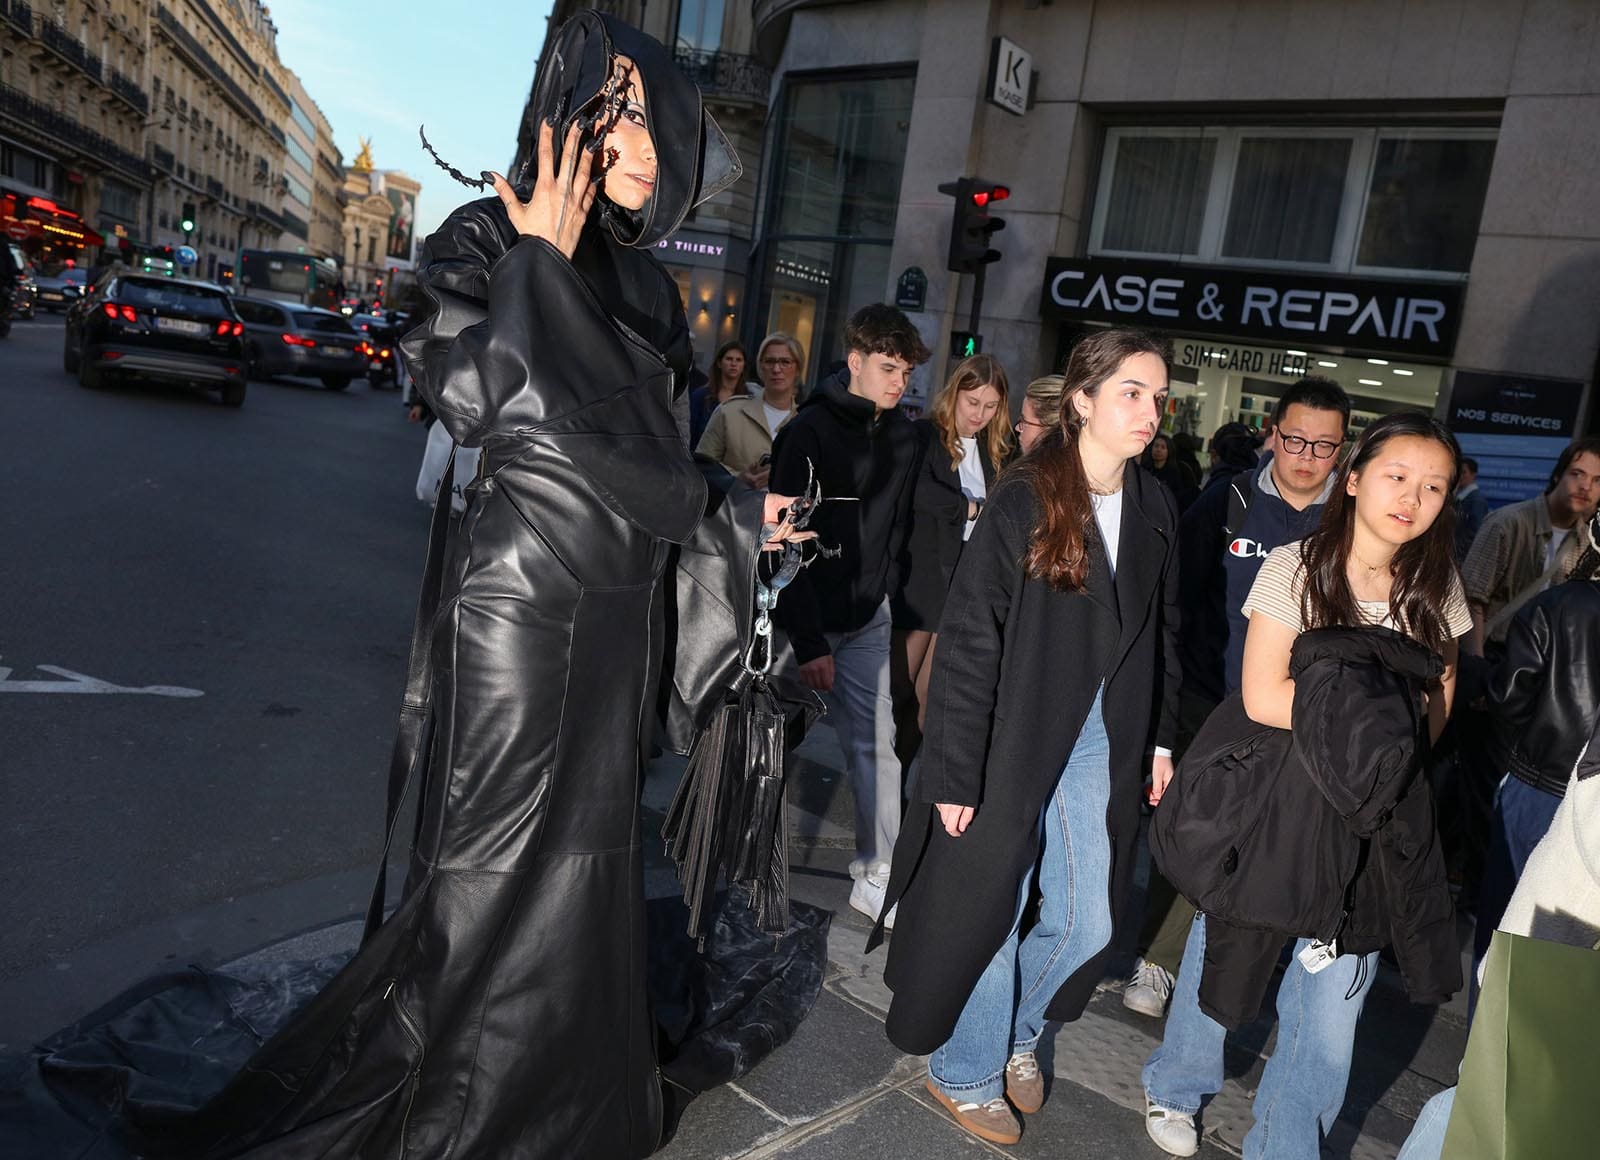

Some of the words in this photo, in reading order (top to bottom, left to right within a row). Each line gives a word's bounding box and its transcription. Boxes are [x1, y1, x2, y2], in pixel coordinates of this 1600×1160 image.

[1005, 51, 1025, 90] K
[1050, 270, 1185, 318] CASE
[1196, 282, 1225, 322] &
[1241, 285, 1447, 343] REPAIR
[1182, 344, 1212, 369] SIM
[1218, 347, 1263, 374] CARD
[1456, 407, 1486, 421] NOS
[1490, 411, 1562, 430] SERVICES
